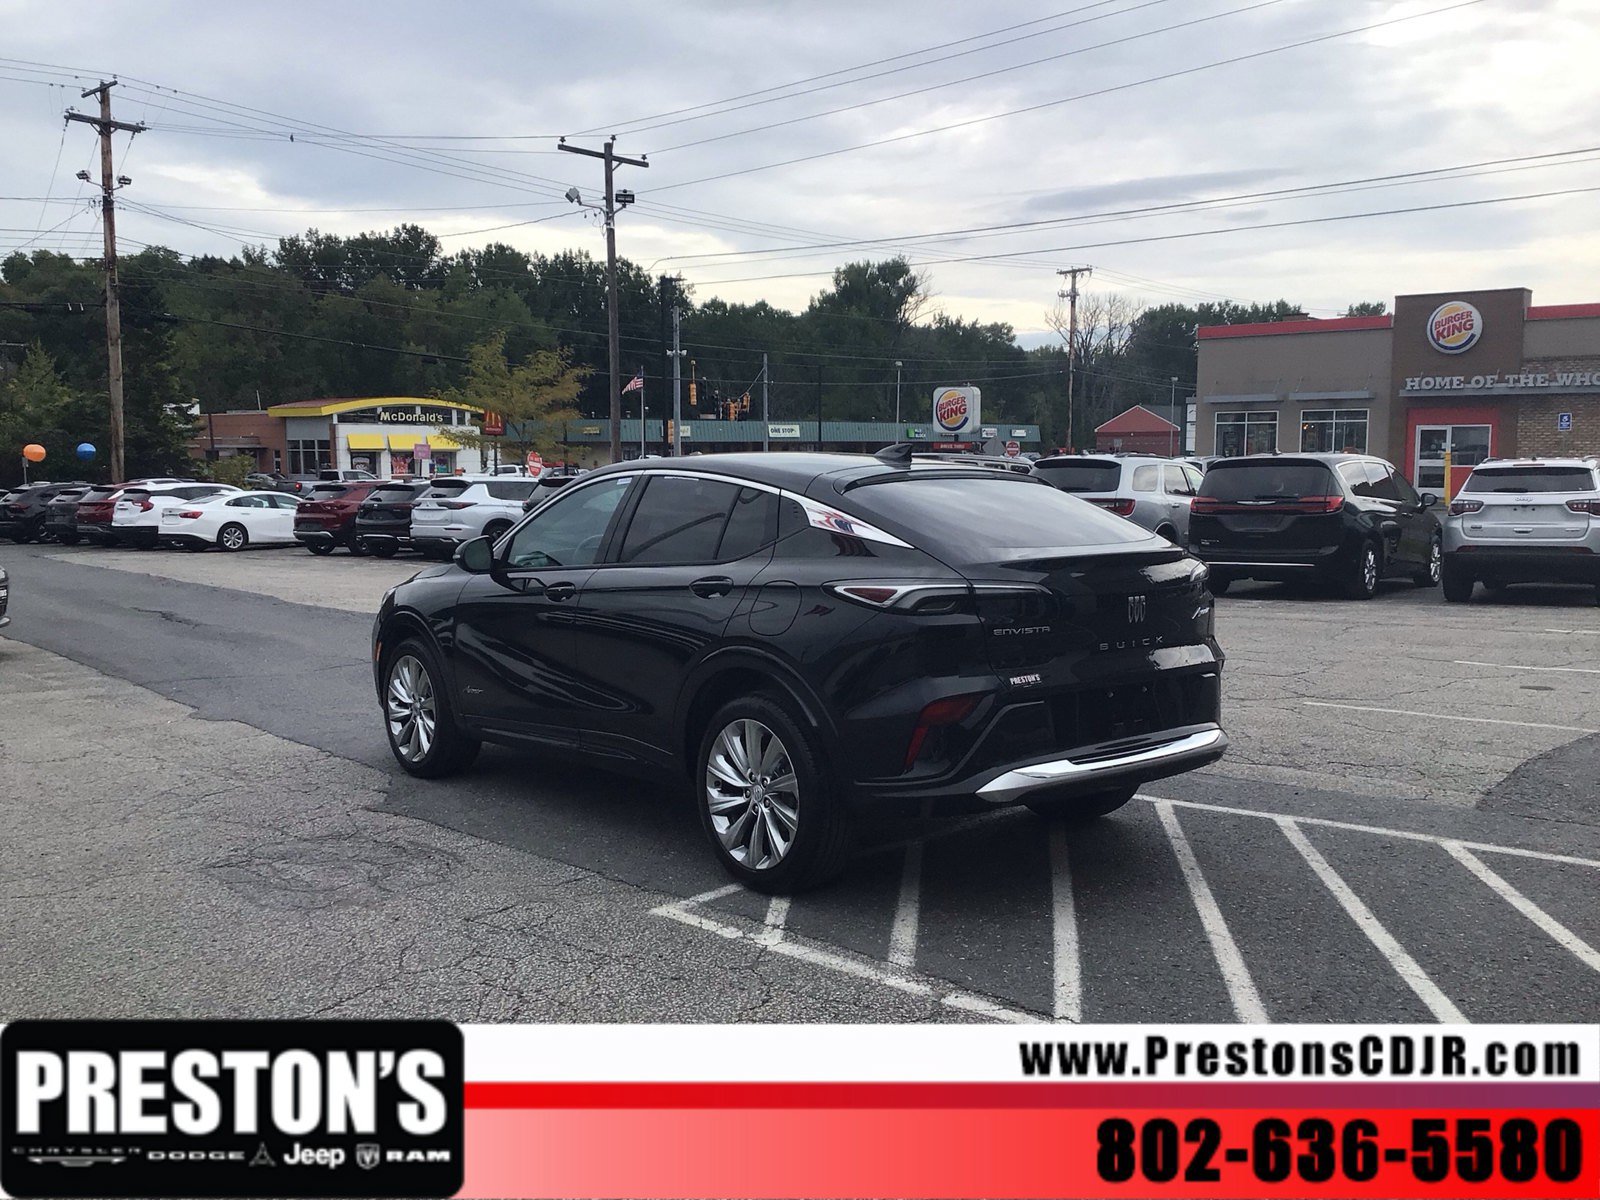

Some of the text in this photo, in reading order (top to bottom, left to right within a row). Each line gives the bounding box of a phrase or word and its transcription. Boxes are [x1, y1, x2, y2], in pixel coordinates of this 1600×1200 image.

[1434, 311, 1473, 331] BURGER
[1435, 319, 1474, 343] KING
[1405, 375, 1465, 390] HOME
[1470, 374, 1498, 389] OF
[1505, 373, 1549, 387] THE
[938, 396, 967, 412] BURGER
[380, 411, 444, 423] McDonald's
[939, 403, 968, 422] KING
[993, 625, 1050, 636] ENVISTA
[1099, 635, 1163, 650] BUICK
[1009, 673, 1041, 685] PRESTON'S
